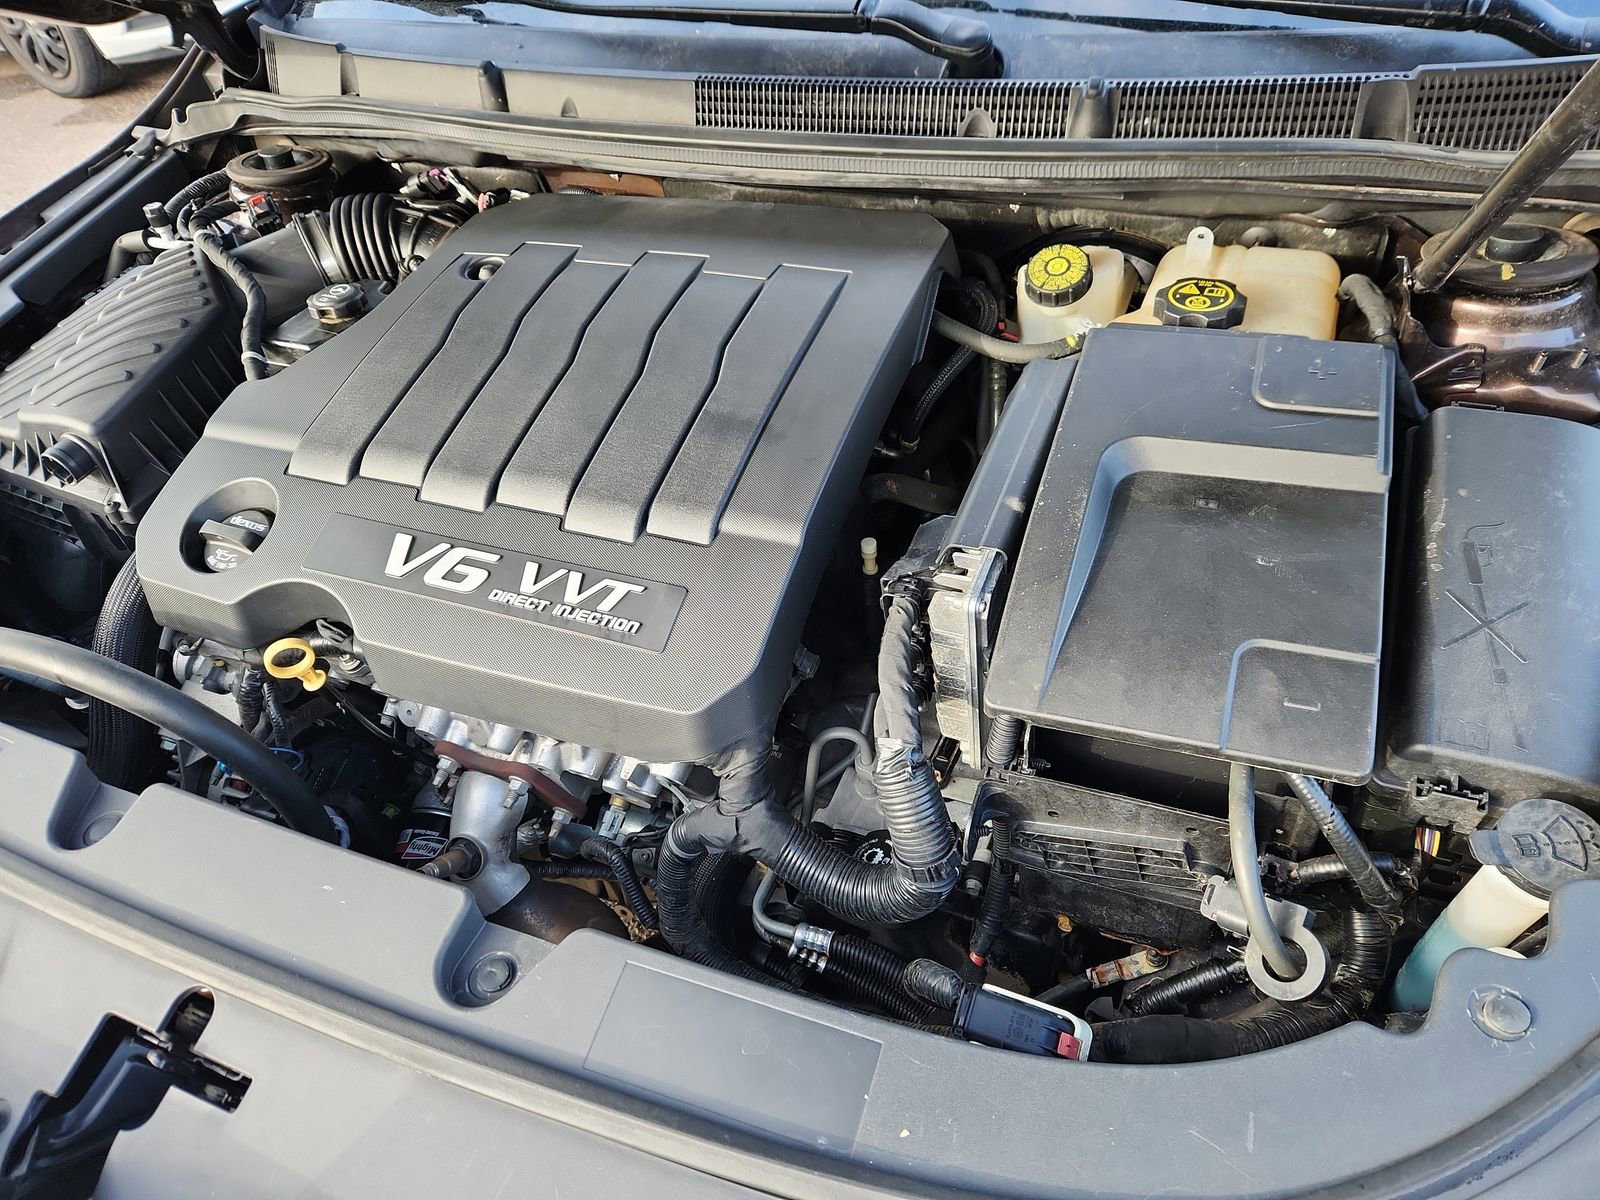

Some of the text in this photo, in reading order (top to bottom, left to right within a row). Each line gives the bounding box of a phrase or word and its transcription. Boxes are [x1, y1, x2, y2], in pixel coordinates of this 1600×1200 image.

[229, 516, 268, 532] dexos
[384, 532, 648, 613] V6 VVT
[488, 588, 643, 635] DIRECT INJECTION
[409, 842, 440, 856] Mighty
